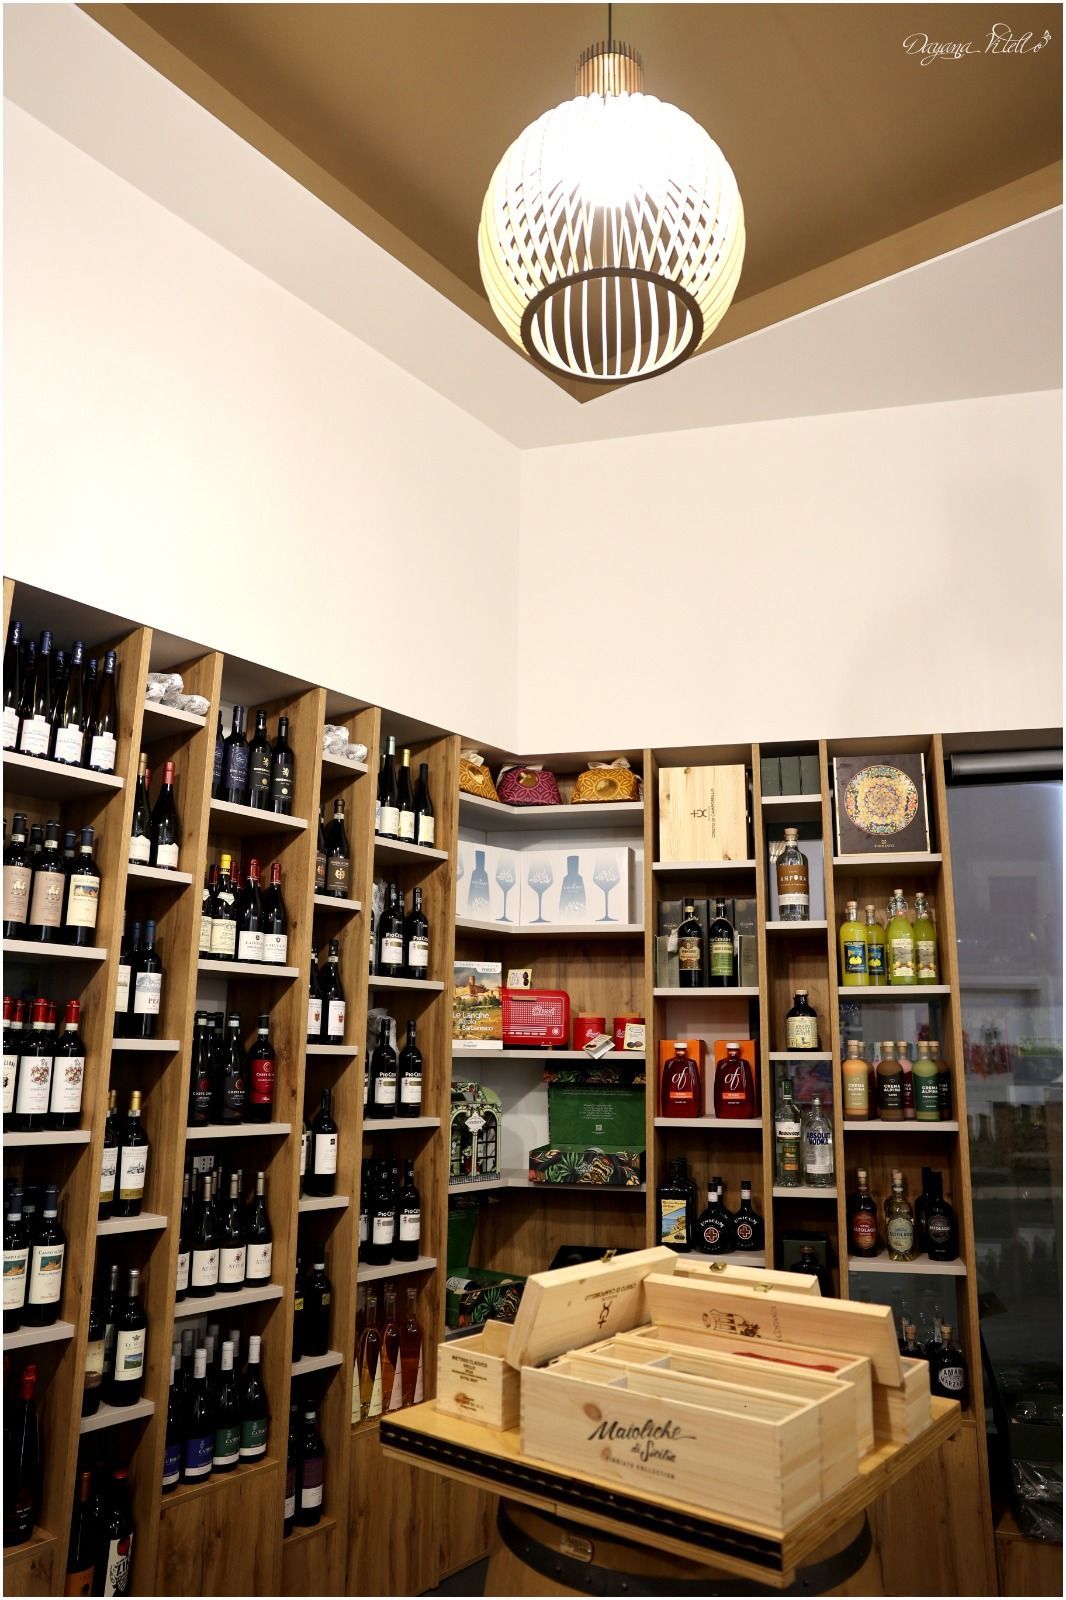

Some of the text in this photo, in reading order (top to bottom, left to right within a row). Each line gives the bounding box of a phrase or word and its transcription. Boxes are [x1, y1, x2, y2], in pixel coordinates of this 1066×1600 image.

[700, 1218, 725, 1228] UNICUM
[733, 1216, 758, 1225] UNICUM
[587, 1419, 697, 1441] Maioliche
[631, 1440, 677, 1463] di Sicilia
